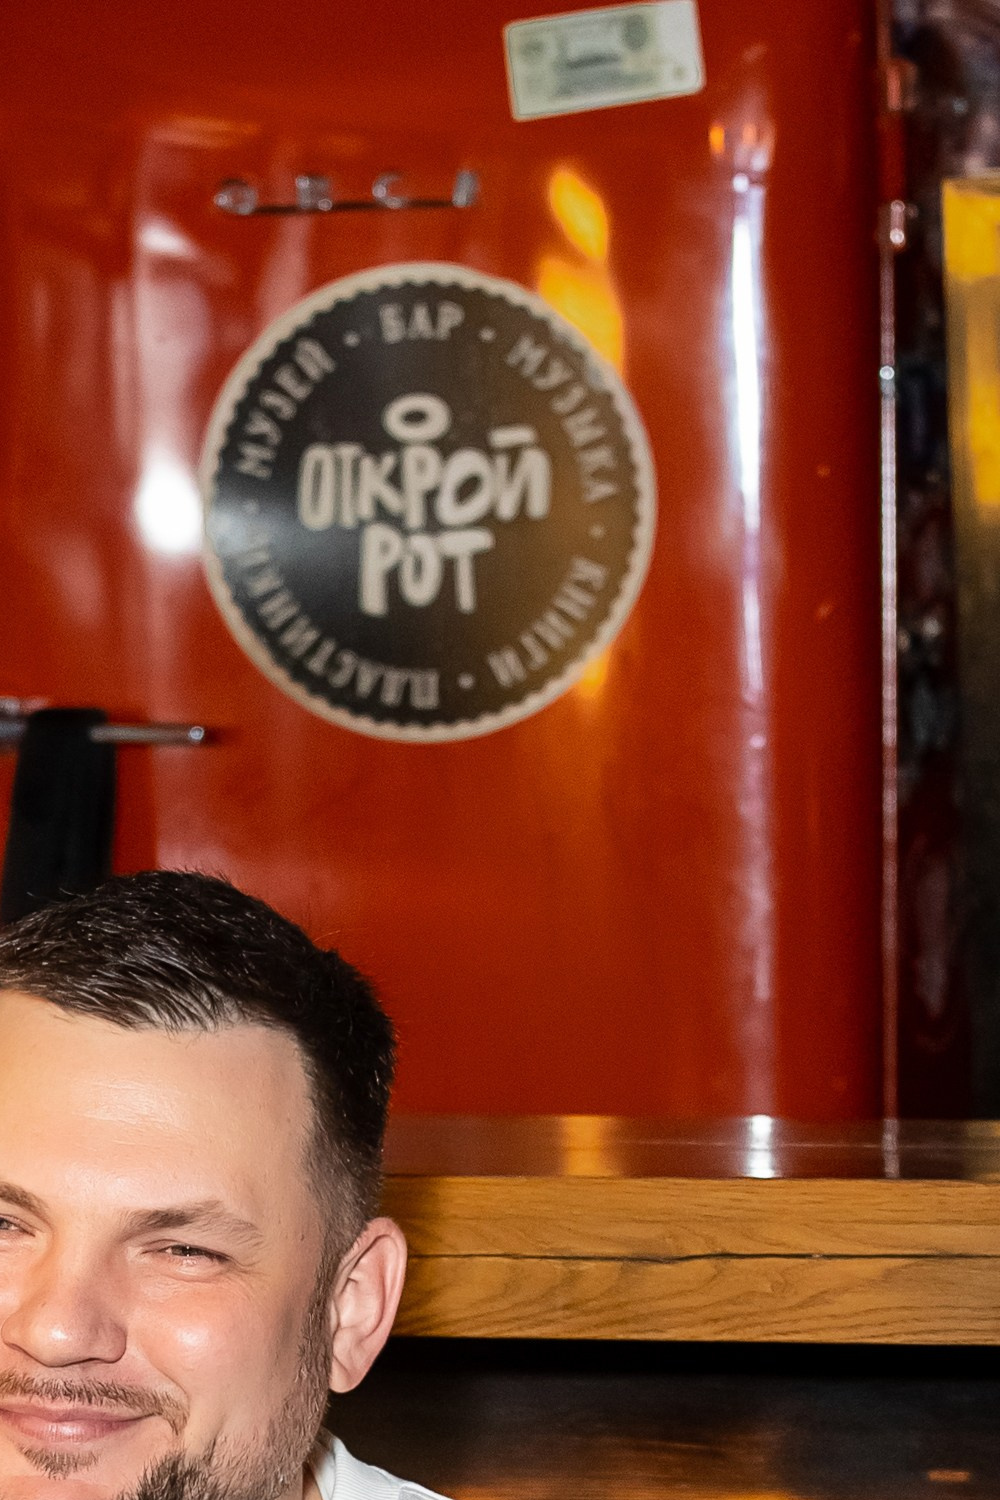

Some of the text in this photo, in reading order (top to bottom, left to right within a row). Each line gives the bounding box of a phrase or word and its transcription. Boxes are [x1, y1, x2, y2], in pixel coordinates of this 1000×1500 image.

[379, 301, 465, 344] БАР
[235, 337, 337, 480] МУЗЕЙ
[506, 335, 621, 502] МУЗЫКА
[299, 424, 553, 531] ОТКРОЙ
[359, 523, 496, 619] РОТ
[487, 556, 610, 688] КНИГИ
